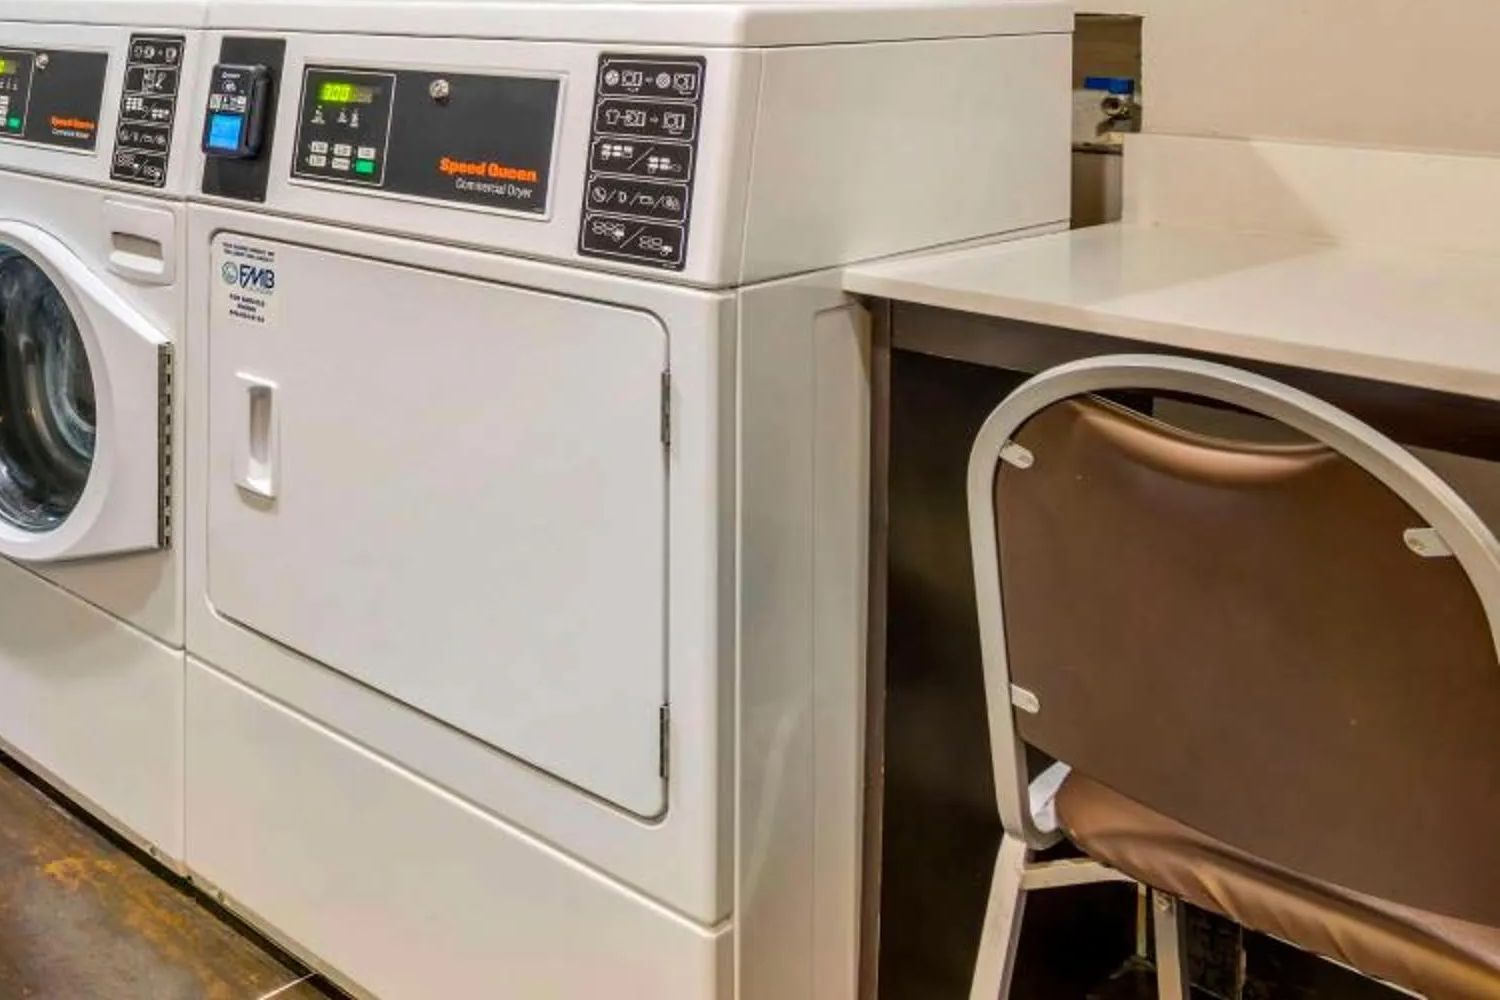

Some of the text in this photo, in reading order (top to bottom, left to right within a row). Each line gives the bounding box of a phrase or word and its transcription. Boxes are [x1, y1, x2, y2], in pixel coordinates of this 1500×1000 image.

[439, 156, 538, 183] Speed Queen
[455, 177, 533, 200] Commercial Dryer
[239, 263, 275, 289] FMB
